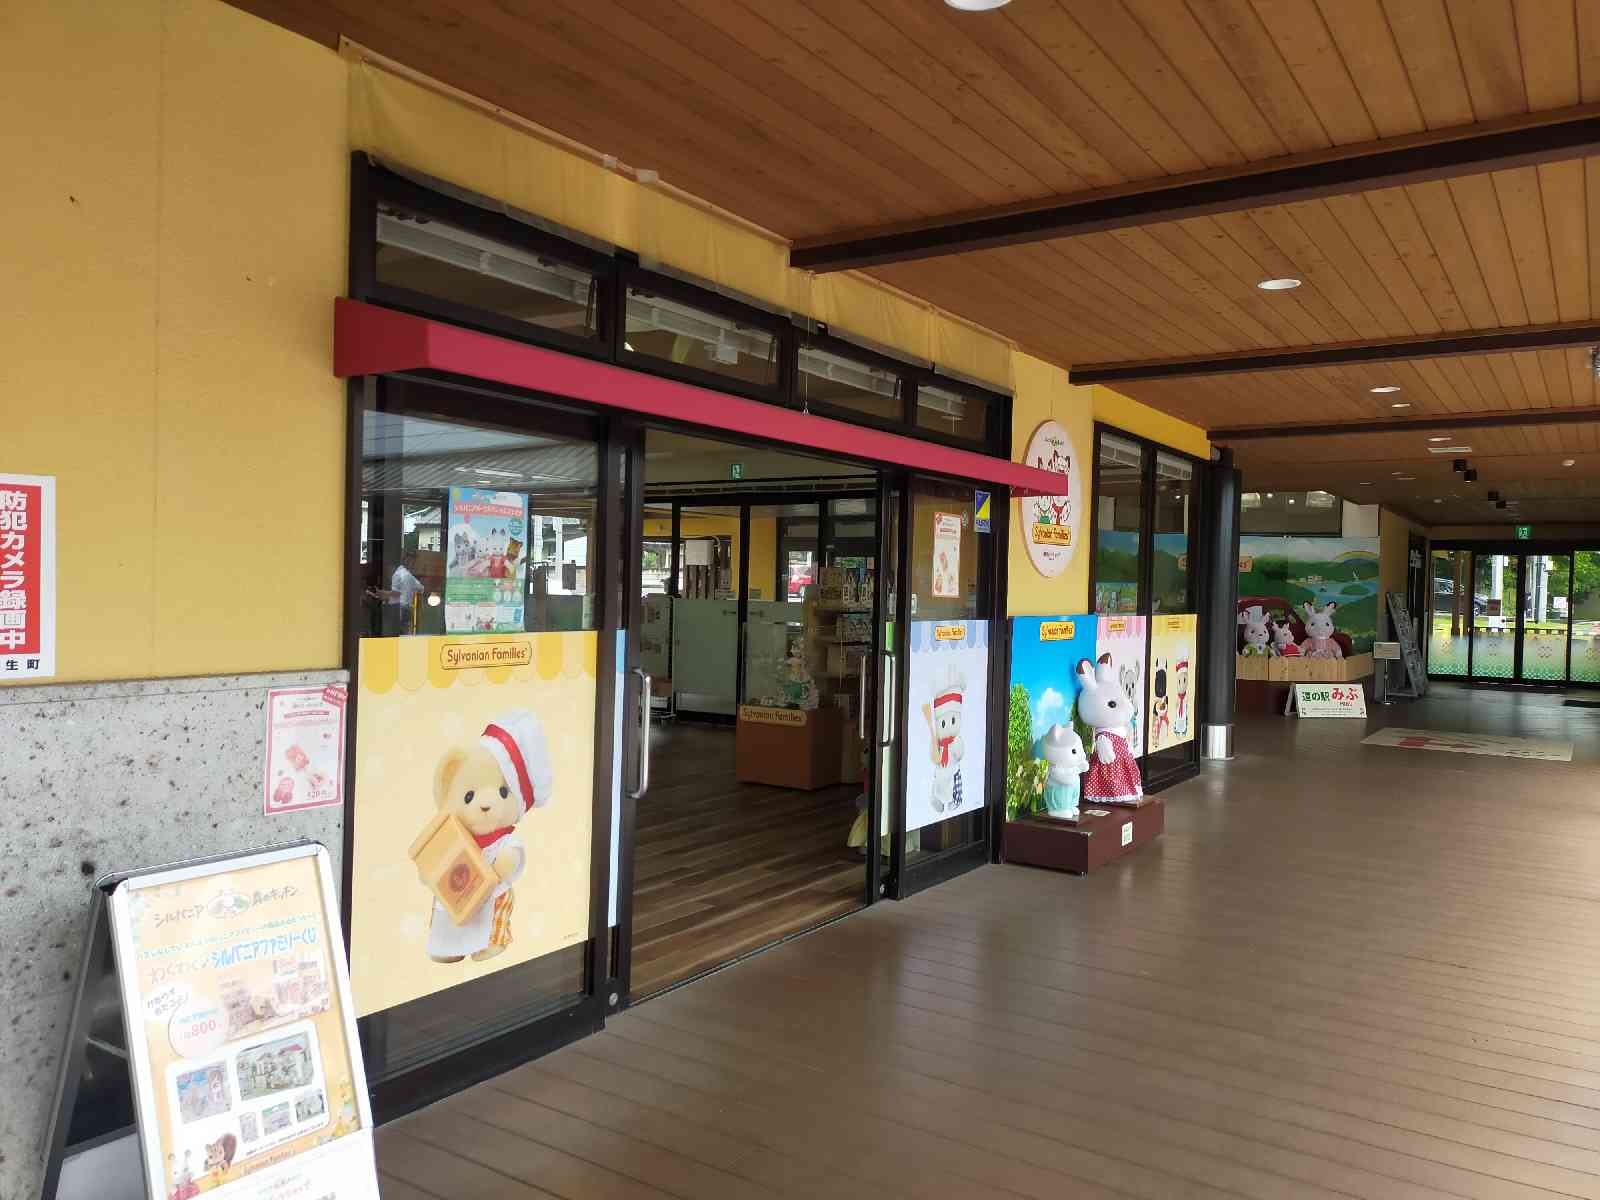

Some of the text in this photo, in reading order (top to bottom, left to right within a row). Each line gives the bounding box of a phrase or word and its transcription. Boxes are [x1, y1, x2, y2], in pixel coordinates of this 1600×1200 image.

[0, 490, 28, 650] 防犯カメラ録画中
[447, 647, 525, 665] Sylvanian Families
